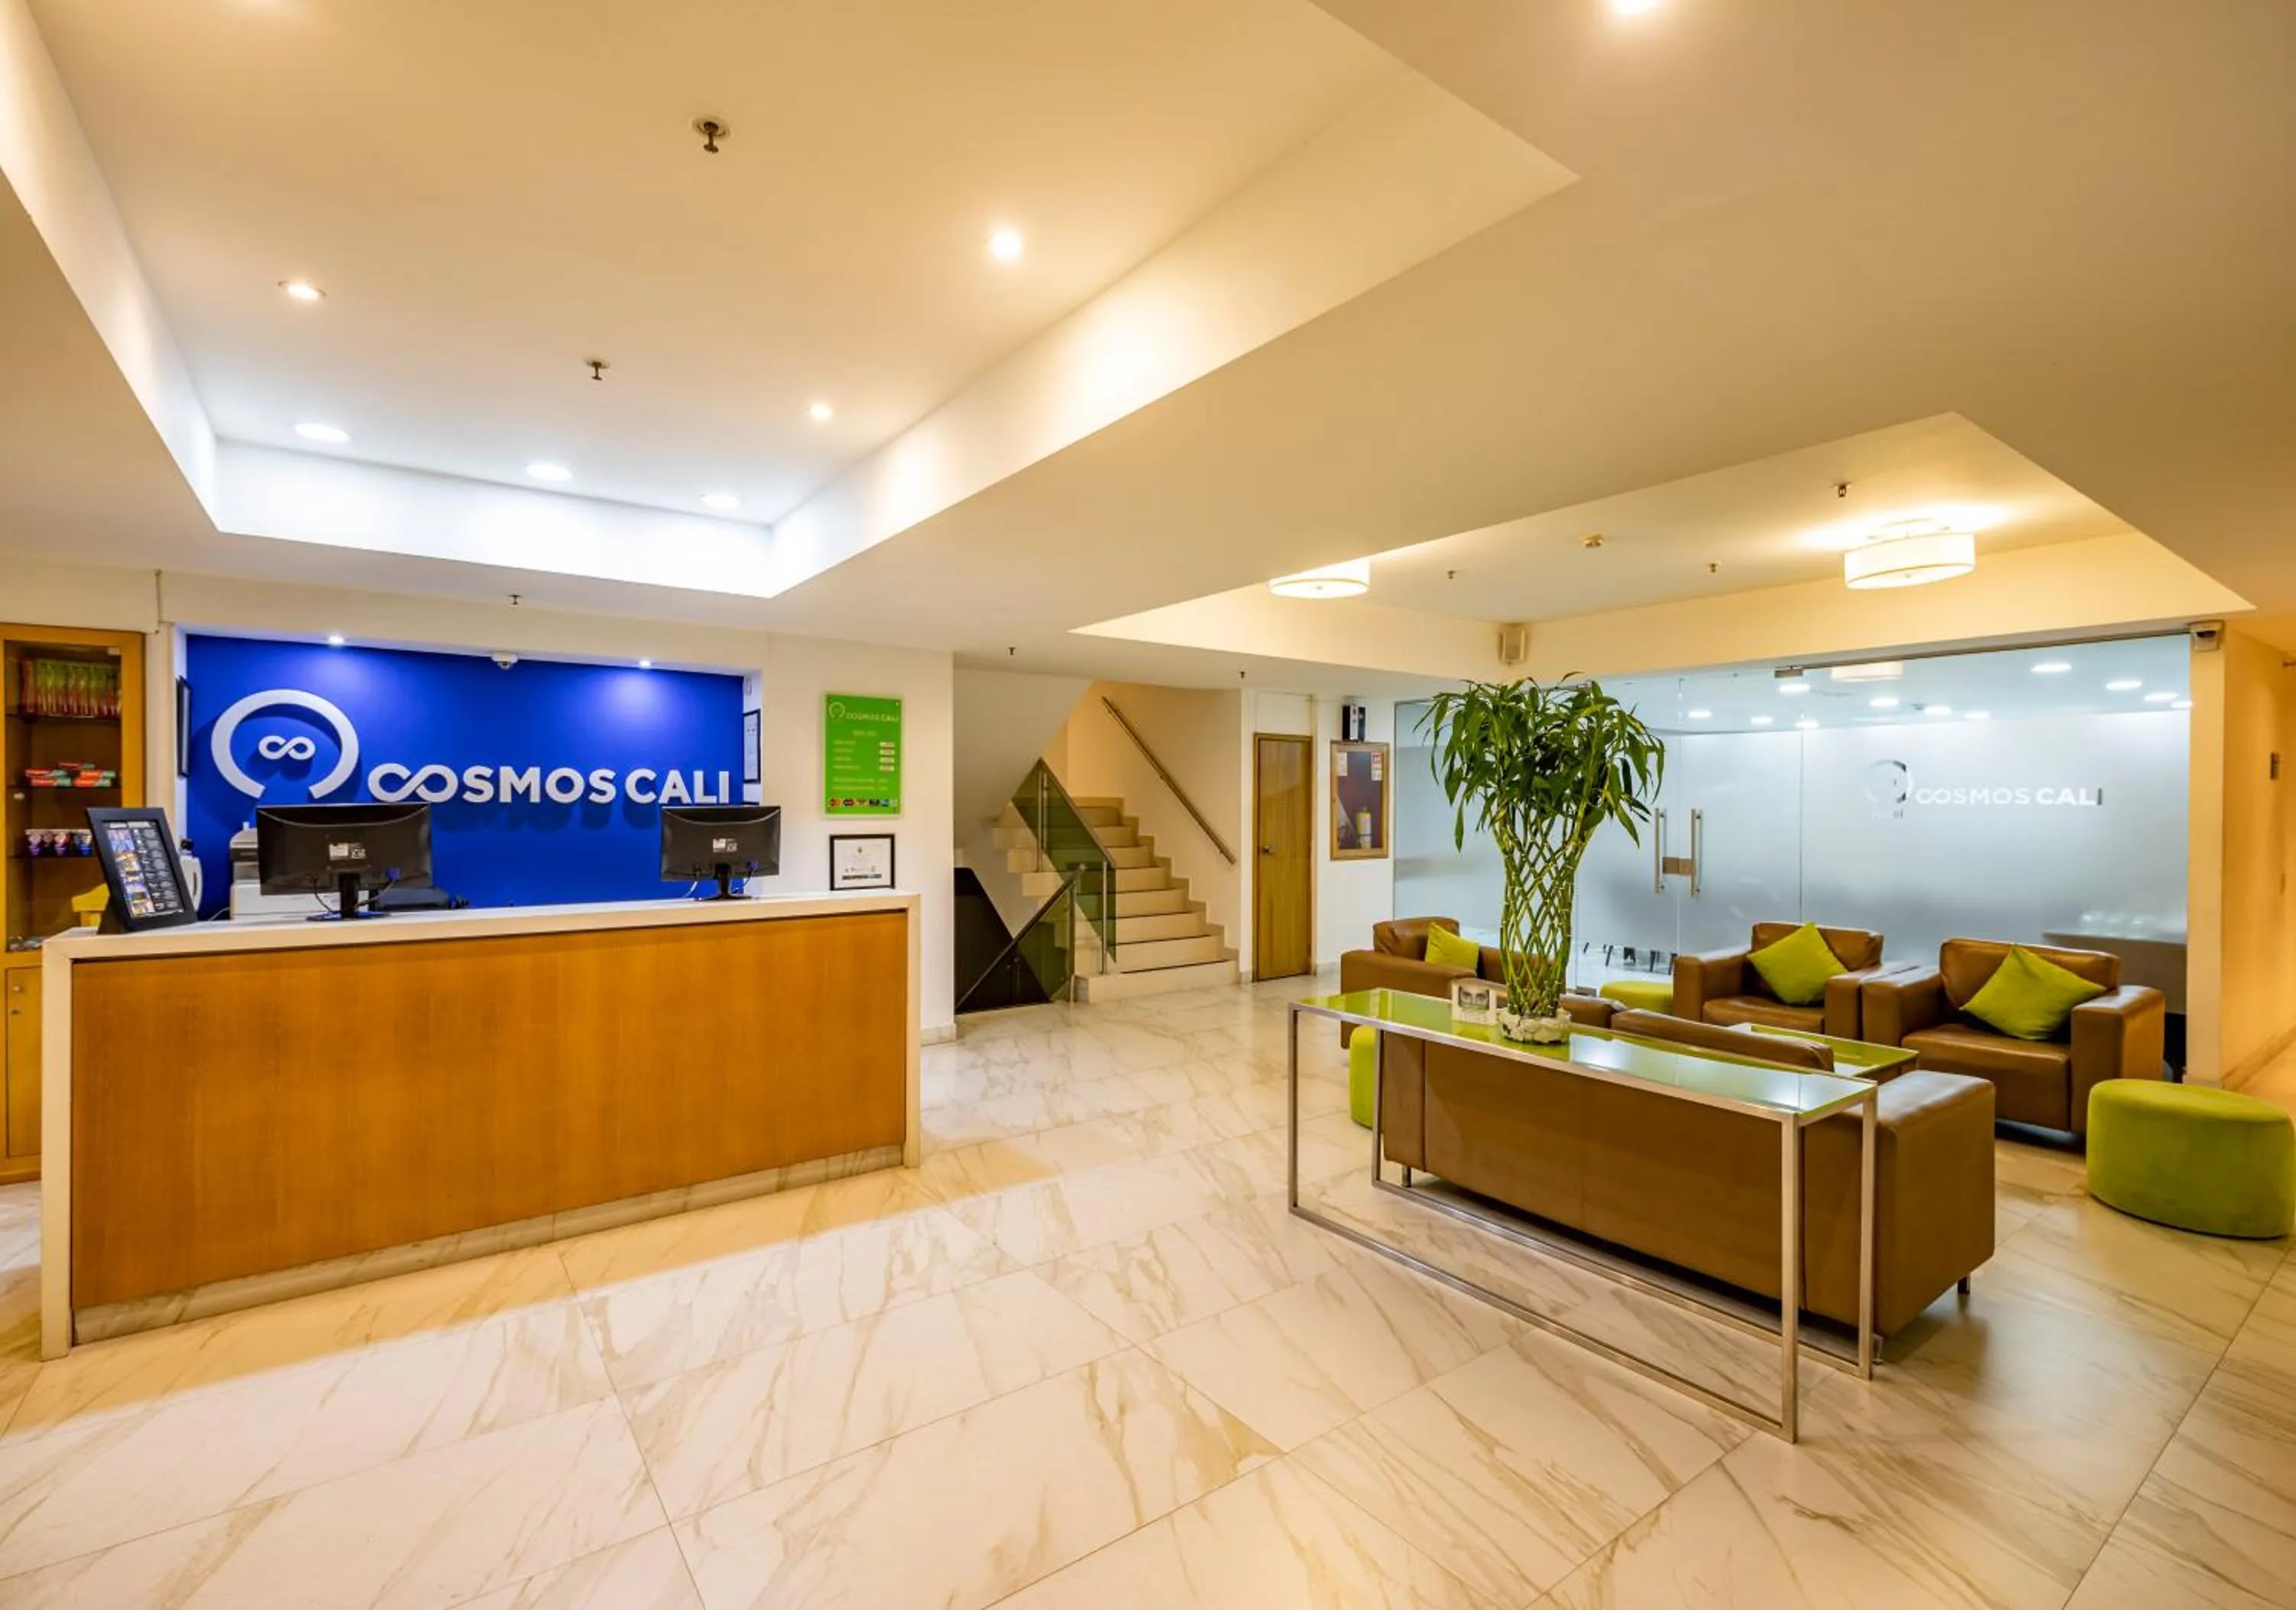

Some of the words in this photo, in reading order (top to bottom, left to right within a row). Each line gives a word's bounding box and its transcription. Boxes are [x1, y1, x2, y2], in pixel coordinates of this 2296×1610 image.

[367, 763, 617, 803] COSMOS
[625, 768, 729, 804] CALI
[1916, 787, 2030, 805] COSMOS
[2035, 787, 2102, 807] CALI
